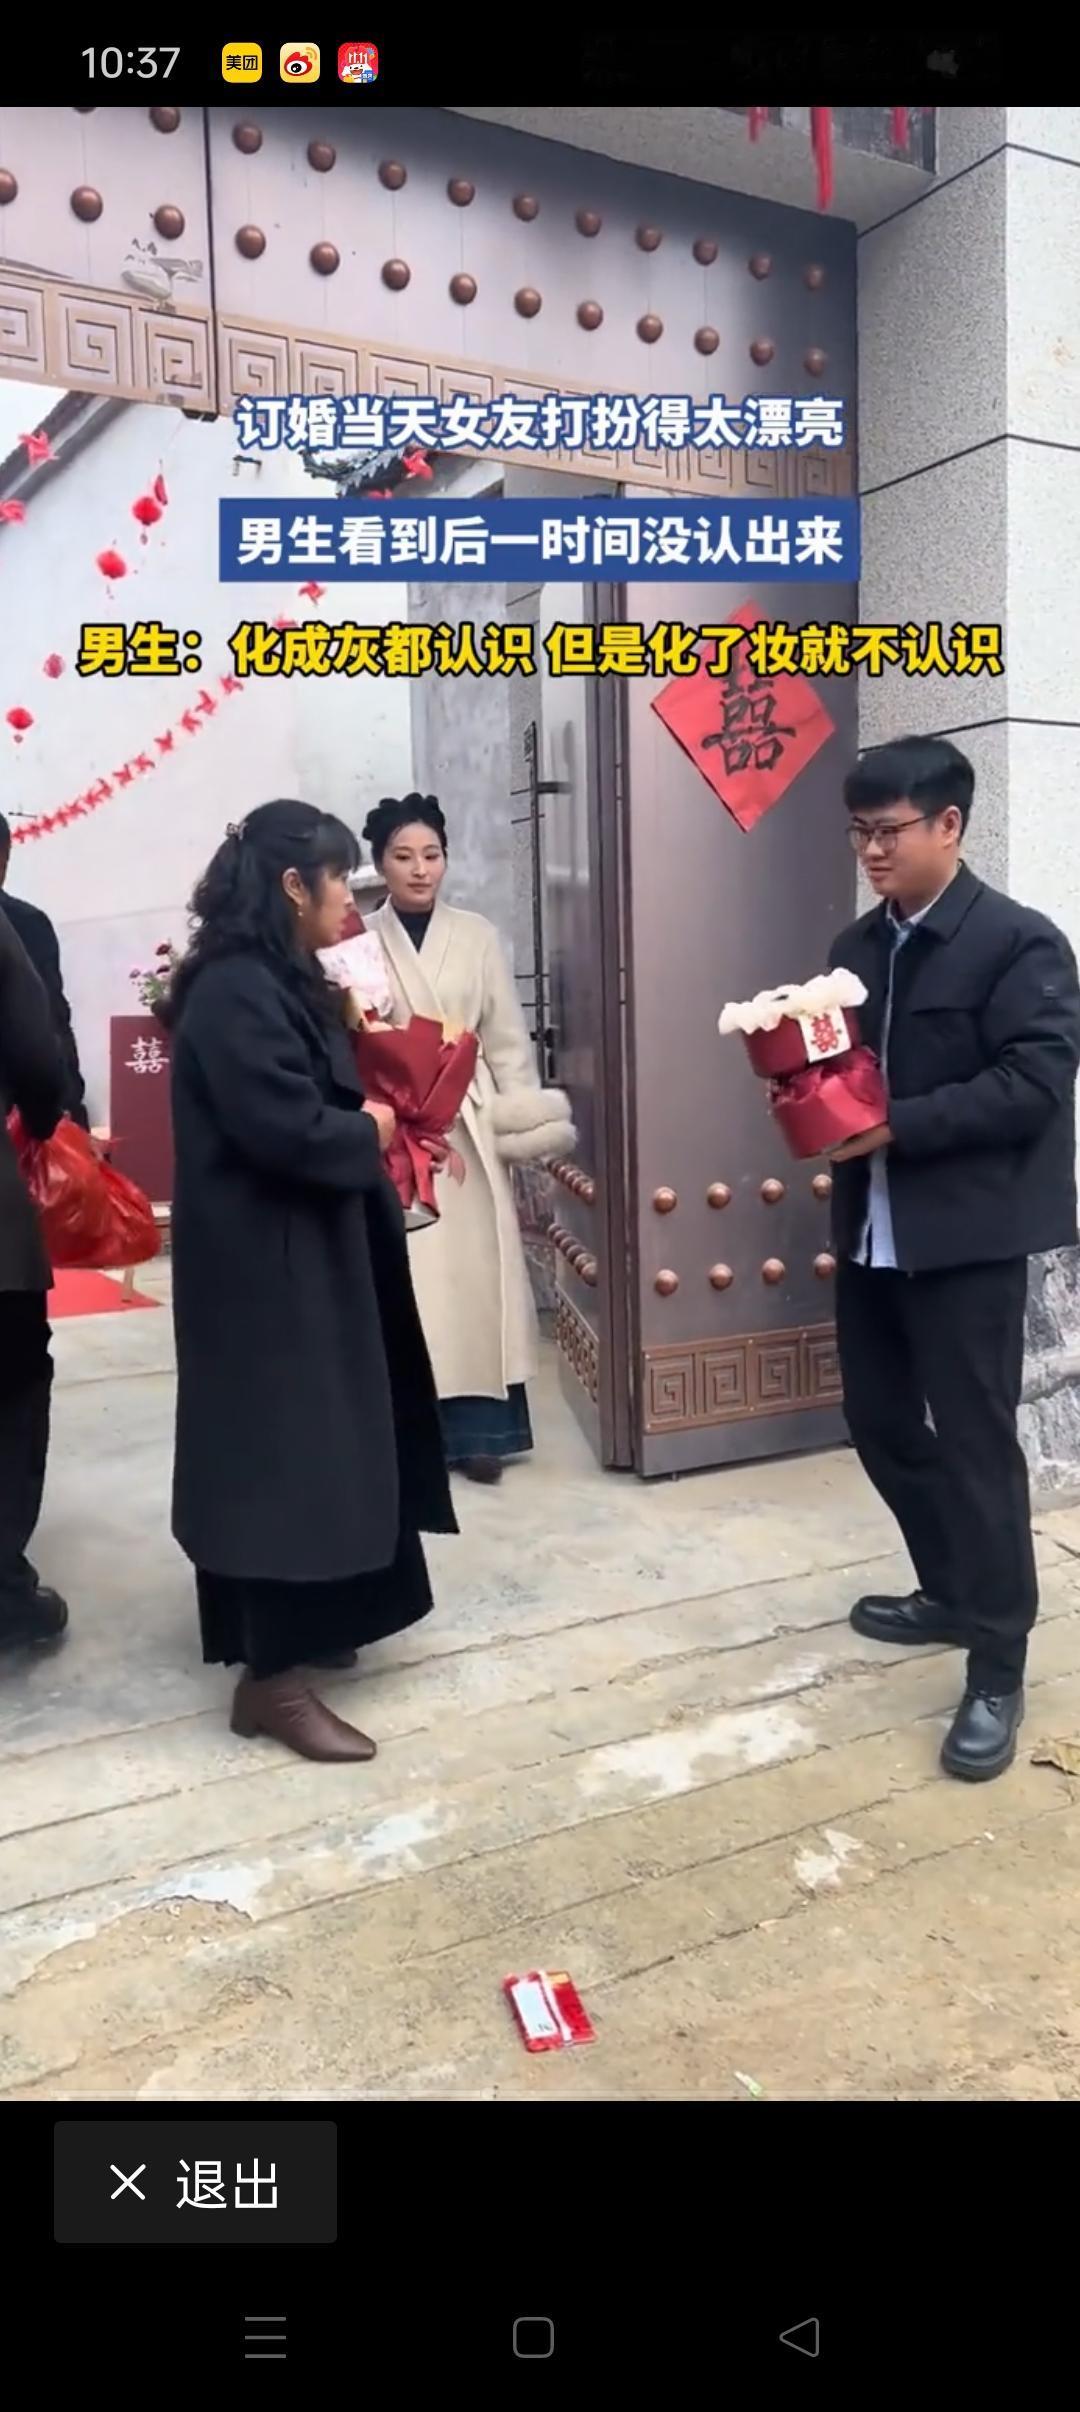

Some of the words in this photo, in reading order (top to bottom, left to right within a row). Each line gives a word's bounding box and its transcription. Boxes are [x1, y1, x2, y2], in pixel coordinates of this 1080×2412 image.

[81, 46, 181, 79] 10:37
[226, 54, 258, 71] 美团
[123, 1035, 170, 1074] 囍
[176, 2157, 278, 2209] 退出
